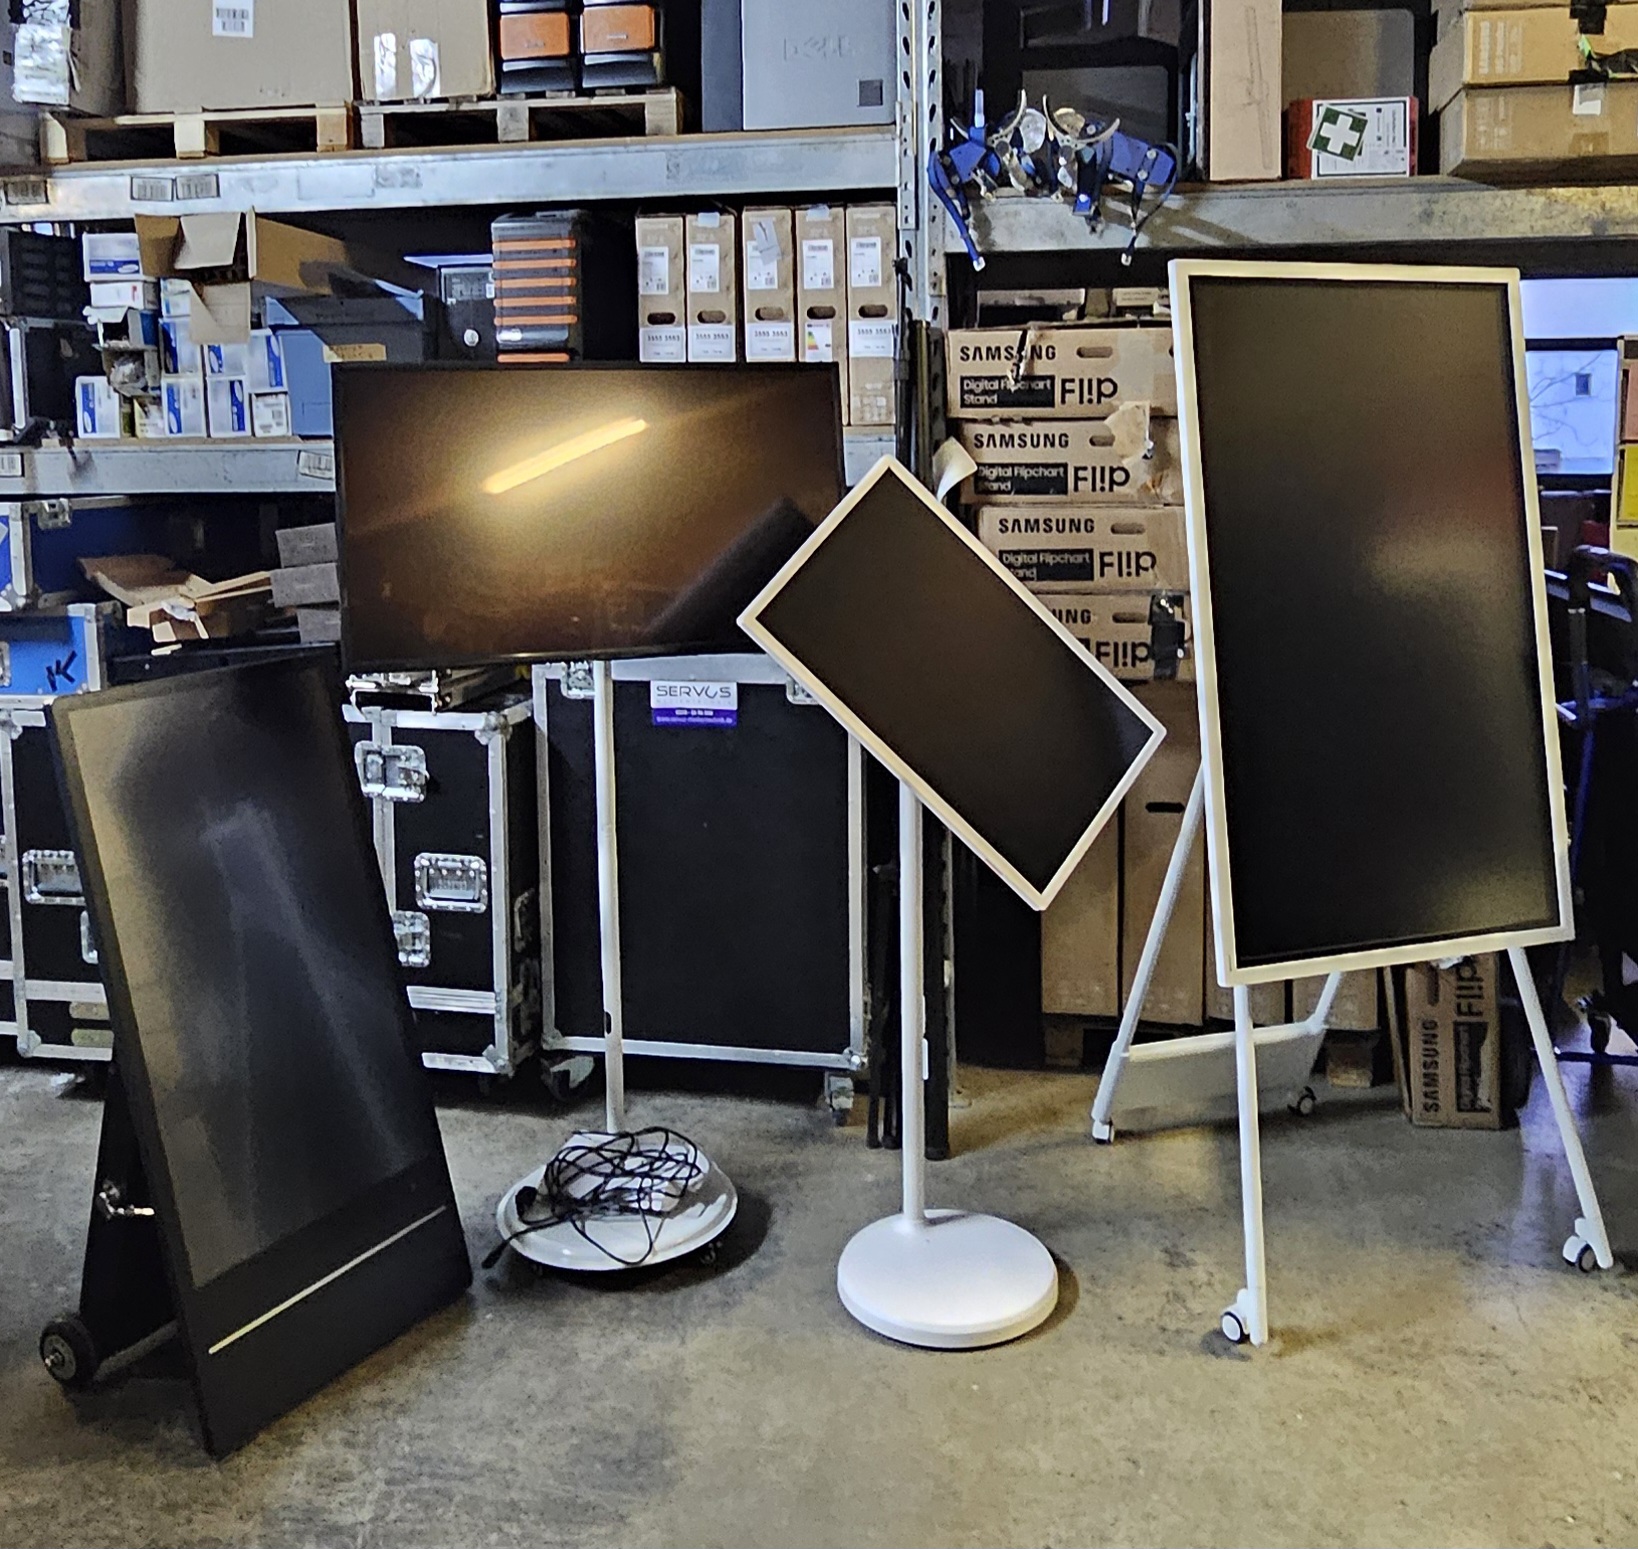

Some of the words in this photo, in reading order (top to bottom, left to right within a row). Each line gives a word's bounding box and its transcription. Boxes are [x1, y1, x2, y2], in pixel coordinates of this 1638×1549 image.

[960, 345, 1056, 361] SAMSNG
[963, 379, 999, 393] Digital
[963, 394, 998, 405] Stand
[973, 433, 1069, 449] SAMSUNG
[1014, 466, 1064, 480] Flipchart
[998, 518, 1095, 534] SAMSUNG
[1002, 553, 1038, 567] Digital
[1039, 552, 1090, 566] Flipchart
[656, 685, 732, 699] SERVUS
[1422, 1019, 1440, 1113] SAMSUNG
